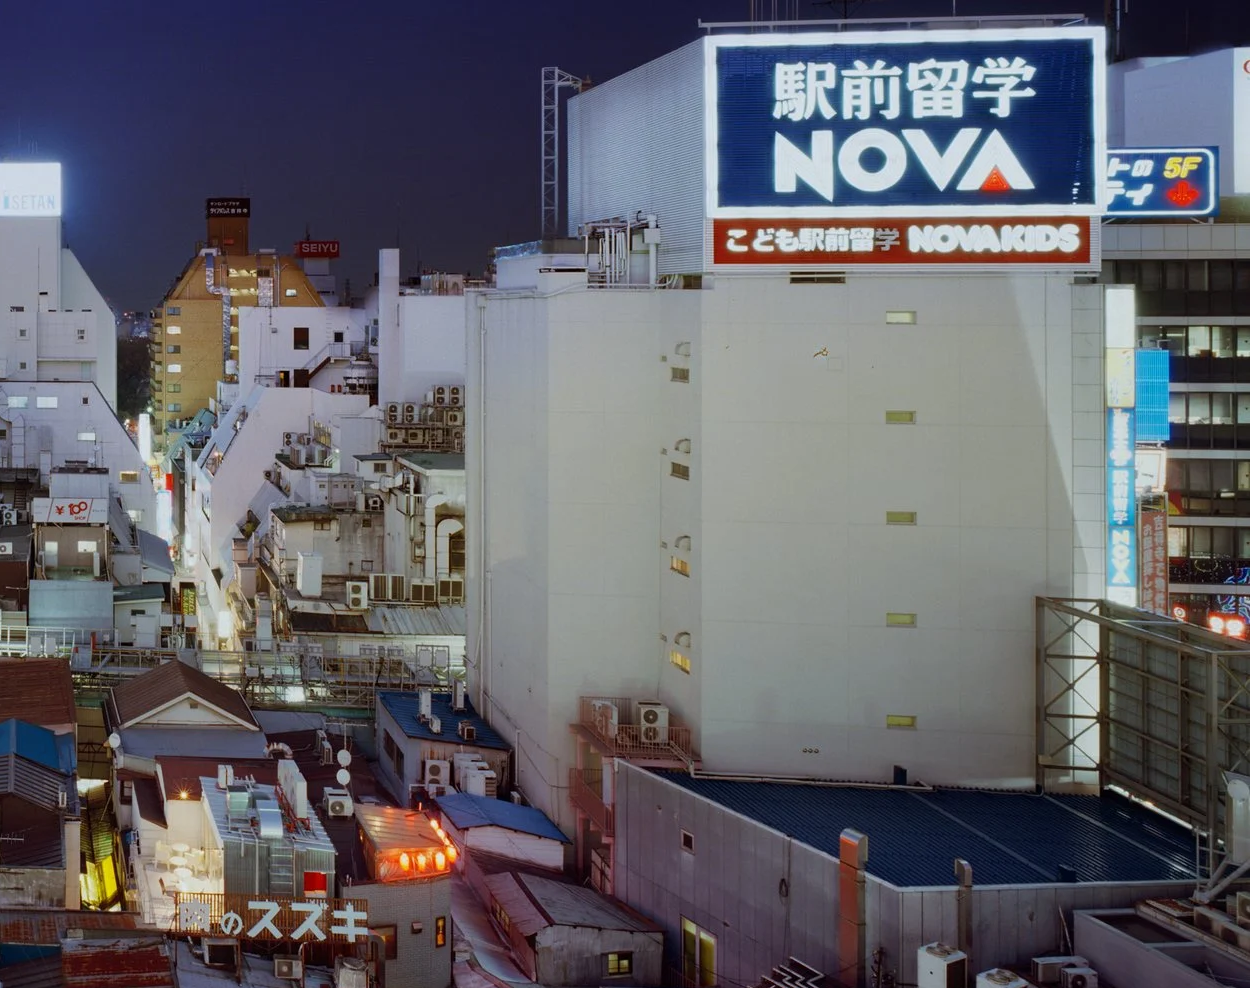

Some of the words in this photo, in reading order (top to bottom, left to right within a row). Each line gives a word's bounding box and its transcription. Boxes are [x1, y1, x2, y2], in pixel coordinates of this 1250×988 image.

[772, 56, 1037, 122] 駅前留学
[774, 127, 1036, 202] NOVA
[1163, 156, 1203, 179] 5F
[301, 243, 338, 253] SEIYU
[726, 227, 900, 253] こども駅前留学
[179, 898, 369, 943] 肉のスズキ
